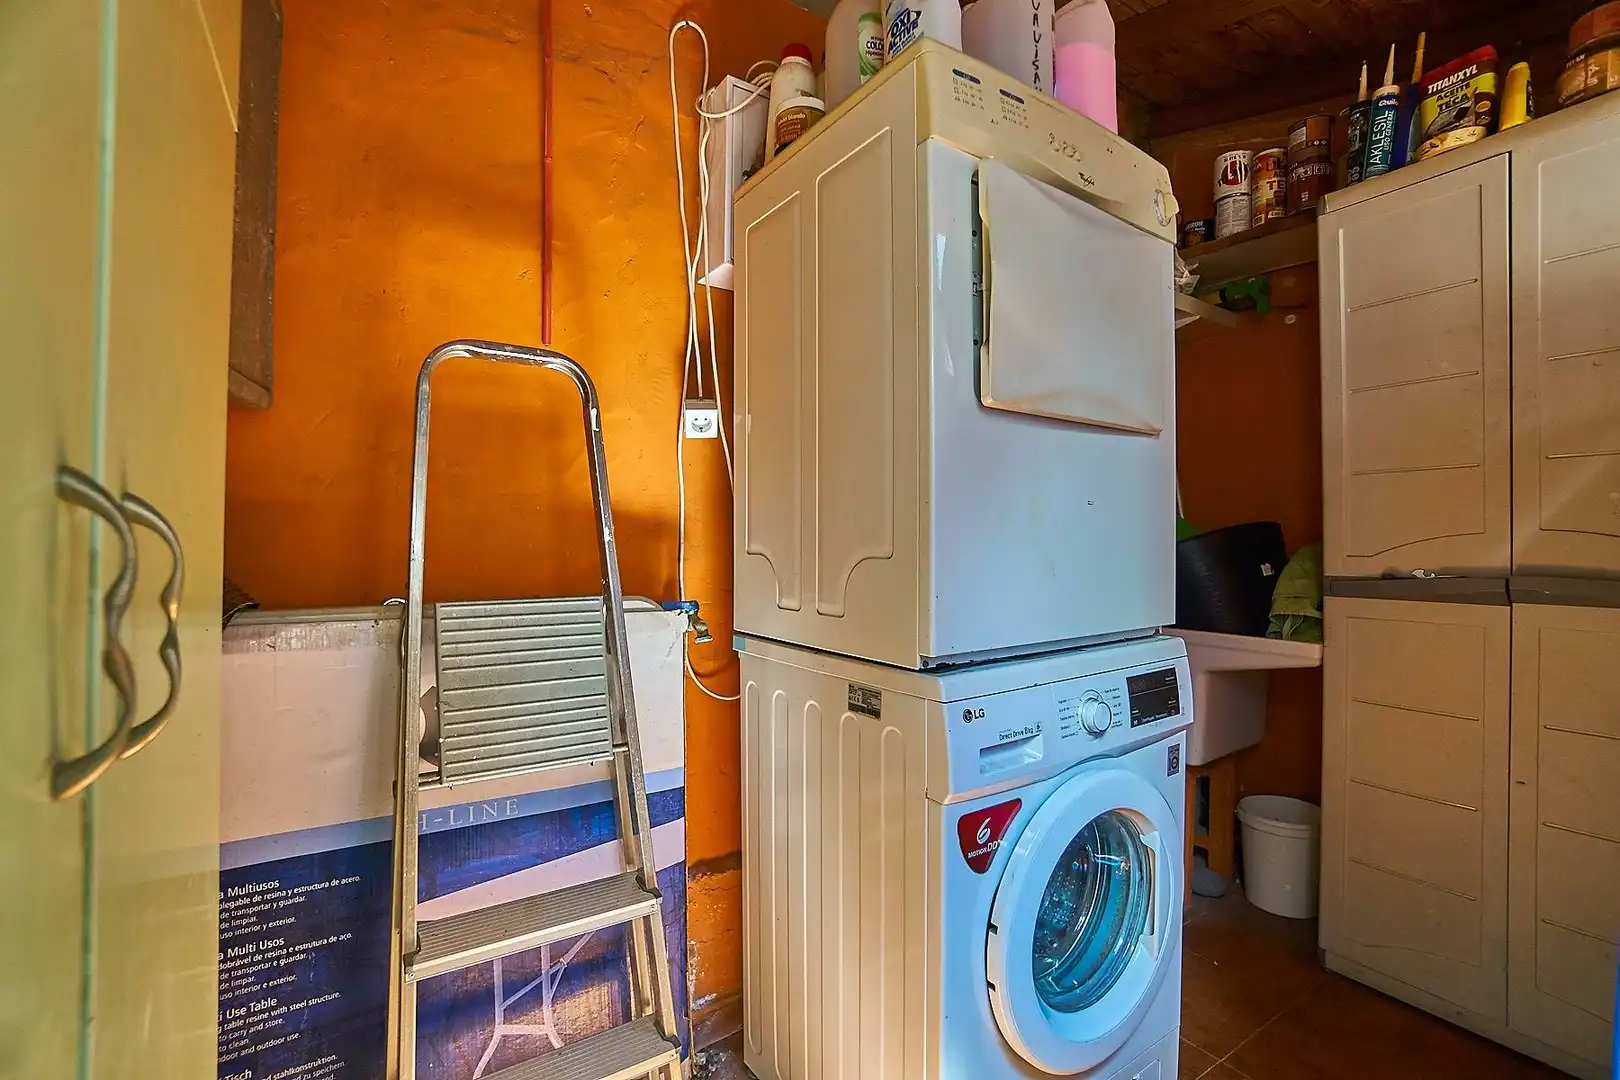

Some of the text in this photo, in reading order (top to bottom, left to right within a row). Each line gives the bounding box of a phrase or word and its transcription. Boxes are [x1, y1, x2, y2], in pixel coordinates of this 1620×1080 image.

[890, 9, 911, 39] OXI
[887, 19, 919, 56] ACTIVE
[1427, 64, 1478, 95] TITANXYL
[1435, 81, 1471, 103] ACEITE
[1437, 92, 1470, 111] TECA
[1369, 110, 1388, 164] AKLESIL
[1383, 137, 1391, 151] USO
[973, 708, 985, 720] LG
[999, 732, 1013, 741] Direct
[1012, 729, 1024, 738] Drive
[976, 816, 992, 845] 6
[227, 880, 280, 898] Multiusos
[252, 894, 263, 903] de
[263, 890, 287, 900] resina
[287, 889, 293, 897] y
[293, 881, 330, 894] estructura
[330, 878, 340, 887] de
[340, 875, 361, 885] acero.
[219, 895, 308, 920] de transportar y guardar.
[219, 915, 259, 930] de limpiar.
[219, 916, 297, 940] uso interior y exterior.
[227, 941, 257, 958] Multi
[259, 937, 285, 950] Usos
[252, 953, 263, 962] de
[264, 948, 288, 959] resina
[294, 938, 328, 952] estrutura
[328, 935, 338, 943] de
[338, 932, 353, 941] aço.
[219, 972, 230, 980] de
[231, 961, 272, 978] transportar
[279, 952, 308, 967] guardar.
[219, 975, 257, 990] de limpar.
[219, 991, 233, 1001] uso
[234, 983, 261, 996] interior
[268, 974, 298, 987] exterior.
[223, 1018, 245, 1031] table
[246, 1011, 270, 1024] resine
[270, 1005, 288, 1017] with
[289, 999, 307, 1012] steel
[308, 991, 341, 1006] structure.
[226, 1006, 247, 1019] Use
[249, 996, 278, 1013] Table
[228, 1028, 248, 1040] carry
[248, 1022, 264, 1034] and
[264, 1017, 285, 1029] store.
[218, 1031, 301, 1063] door and outdoor use.
[228, 1038, 251, 1050] clean.
[273, 1054, 338, 1080] stahlkonstruktion.
